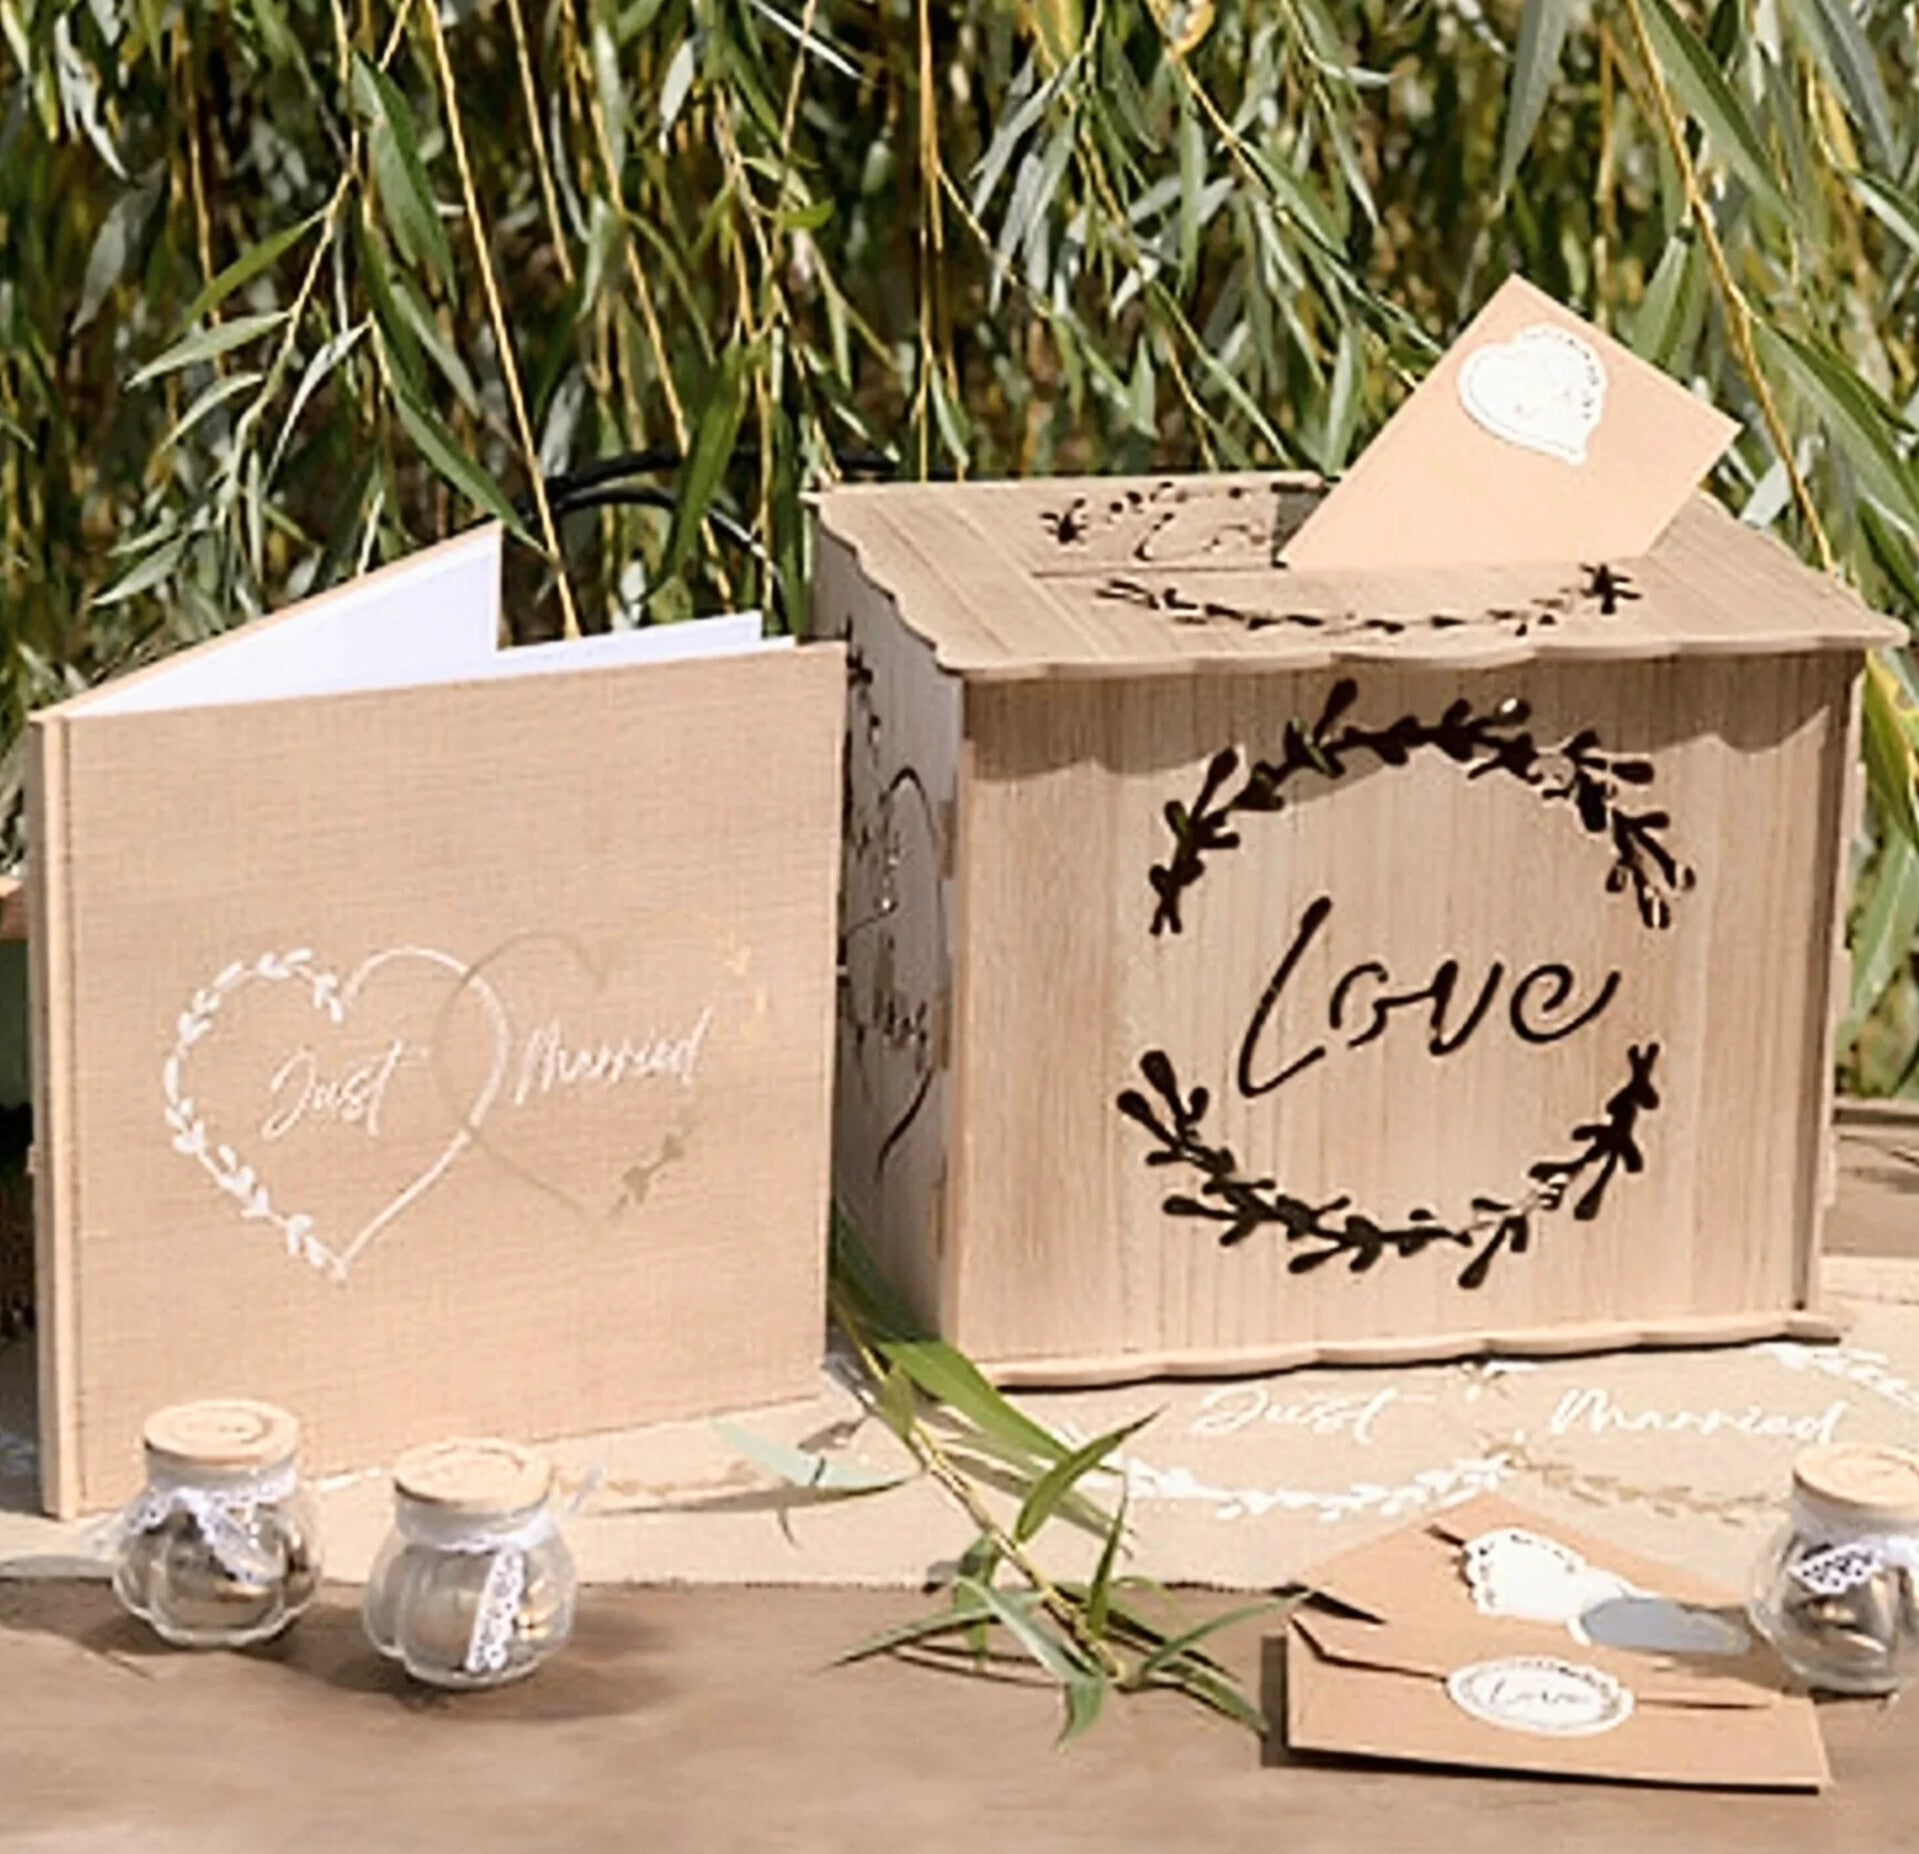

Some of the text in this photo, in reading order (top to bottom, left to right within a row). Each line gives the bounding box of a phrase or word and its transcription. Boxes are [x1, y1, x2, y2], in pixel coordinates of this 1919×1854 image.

[1236, 895, 1623, 1099] Love
[261, 1004, 713, 1140] Just Married
[1190, 1384, 1848, 1446] Just Married
